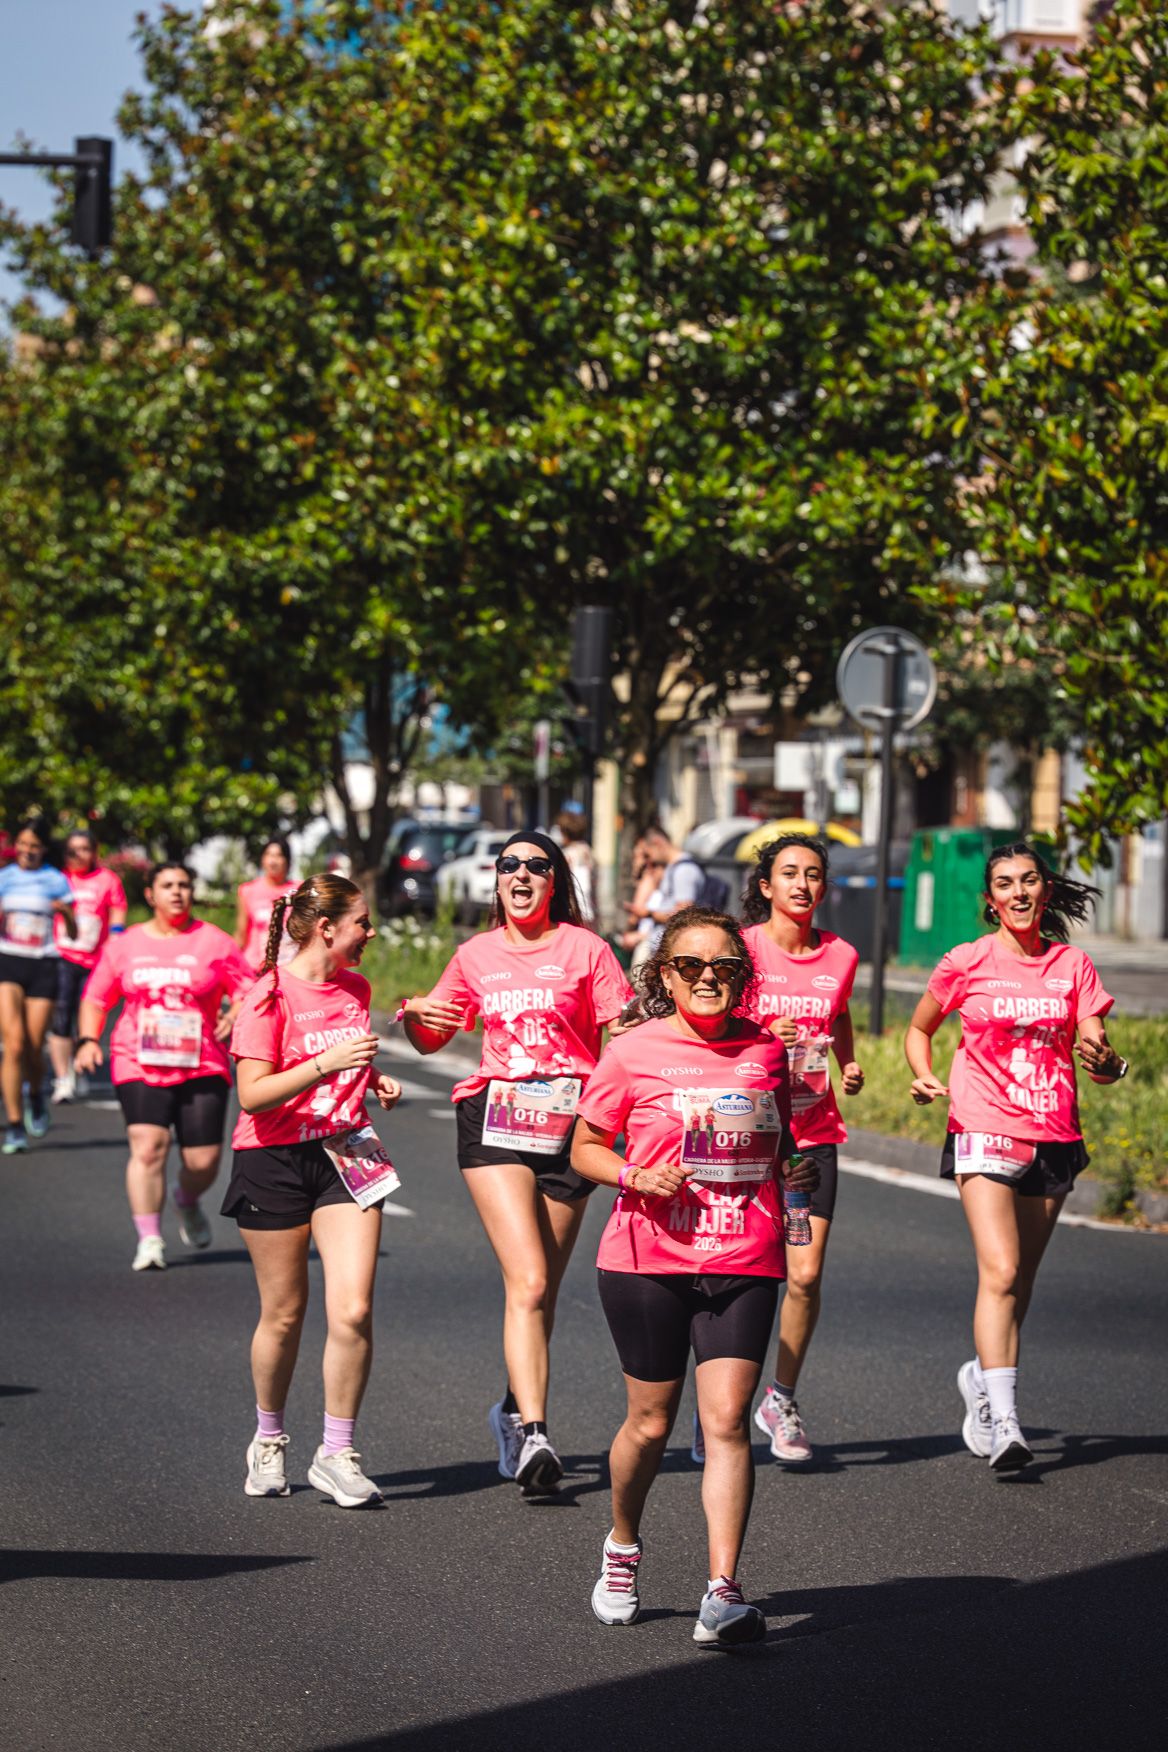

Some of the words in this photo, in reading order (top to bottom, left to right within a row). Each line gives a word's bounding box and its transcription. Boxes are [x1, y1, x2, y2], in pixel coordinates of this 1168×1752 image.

[480, 971, 512, 985] OYSHO
[483, 988, 556, 1016] CARRERA
[758, 994, 832, 1019] CARRERA
[992, 997, 1069, 1019] CARRERA
[293, 1010, 325, 1023] OYSHO
[522, 1017, 549, 1047] DE
[660, 1067, 704, 1077] OYSHO
[717, 1101, 754, 1112] ASTURIANA
[514, 1108, 549, 1125] 016
[715, 1131, 752, 1147] 016
[983, 1134, 1013, 1149] 016
[362, 1147, 389, 1170] 016
[708, 1183, 733, 1207] LA
[668, 1204, 745, 1235] MUJER
